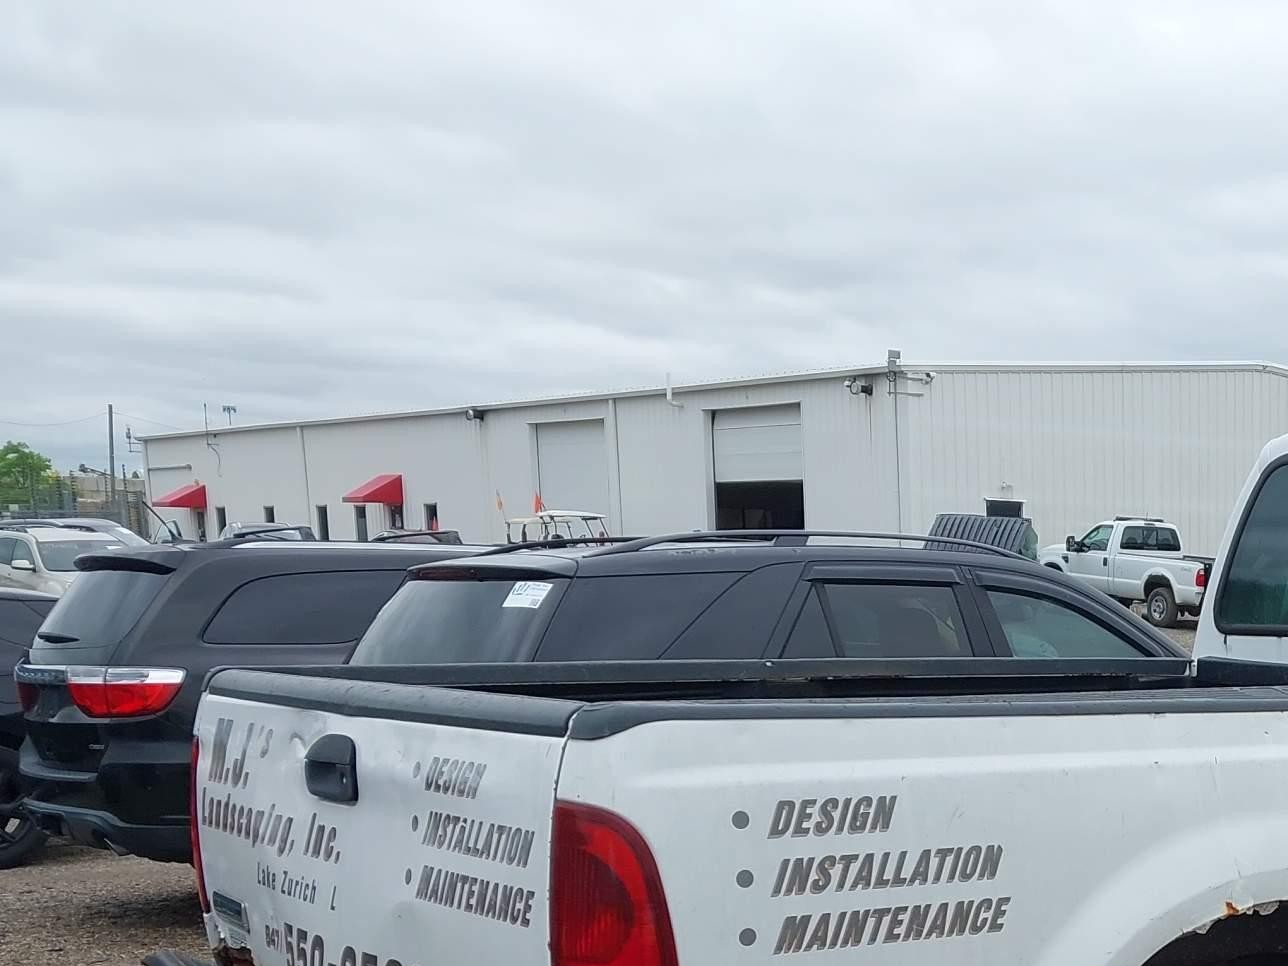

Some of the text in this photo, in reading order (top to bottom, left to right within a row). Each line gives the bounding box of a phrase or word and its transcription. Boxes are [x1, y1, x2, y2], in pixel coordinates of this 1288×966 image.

[208, 717, 274, 789] M.J.'s
[424, 756, 487, 799] DESIGN
[202, 787, 341, 865] Landscaping, Inc.
[421, 810, 536, 868] INSTALLATION
[767, 795, 897, 839] DESIGN
[257, 861, 276, 890] Lake
[416, 864, 536, 928] MAINTENANCE
[770, 844, 1003, 897] INSTALLATION
[773, 896, 1012, 955] MAINTENANCE
